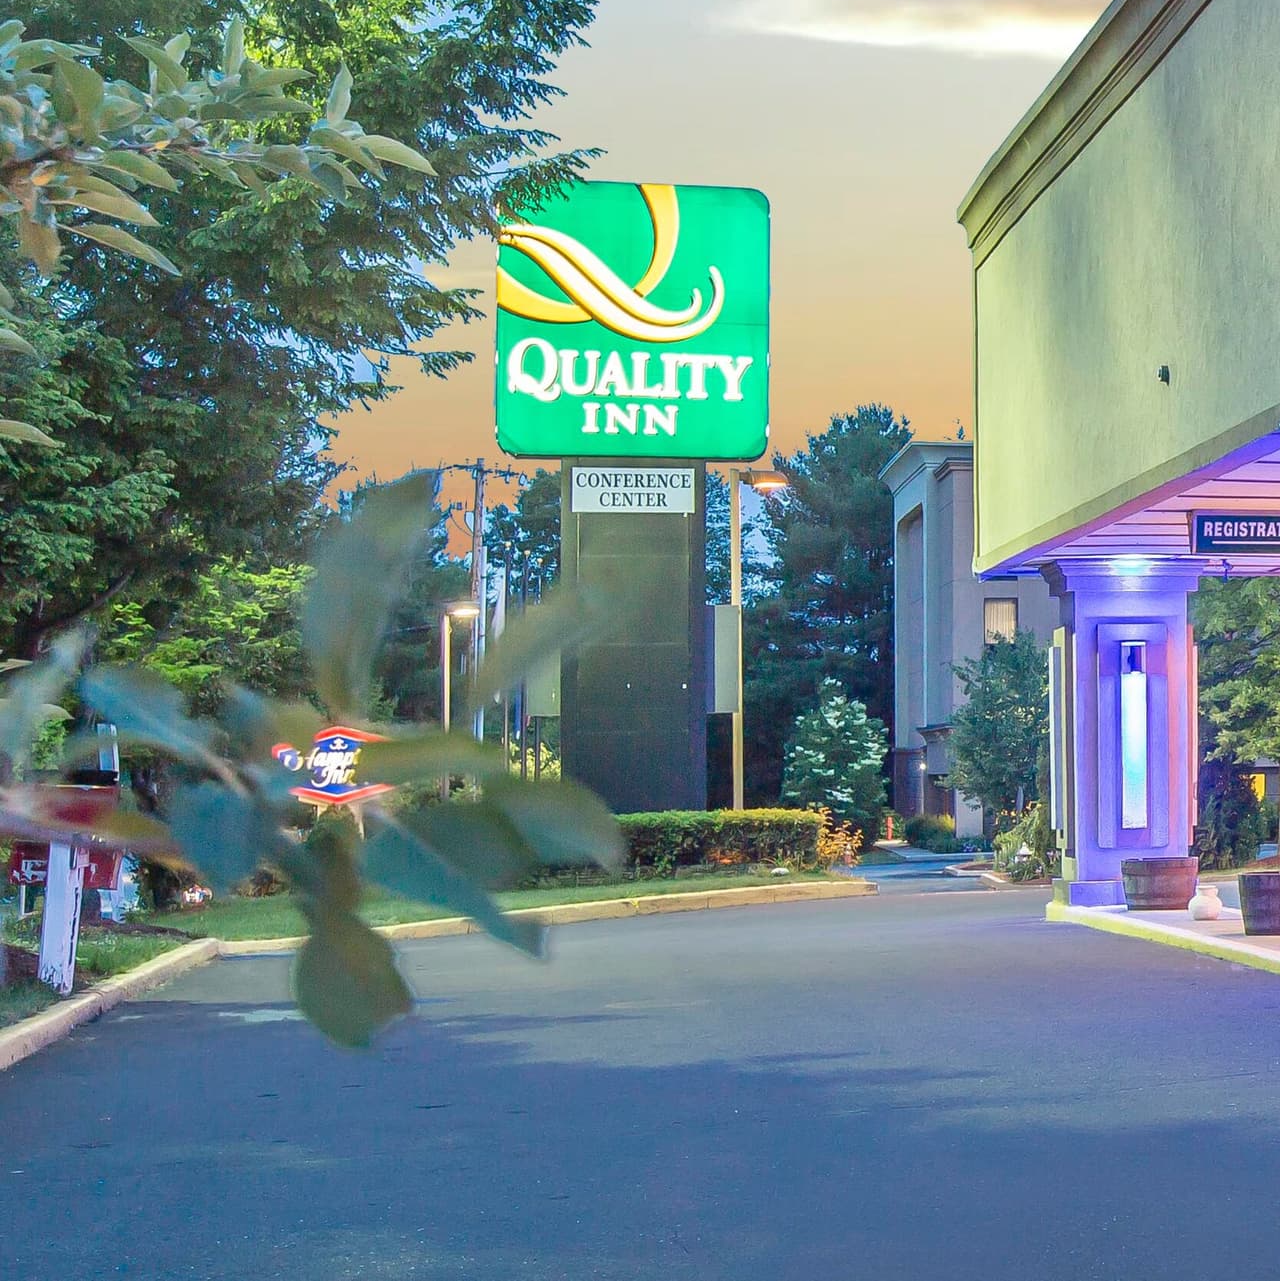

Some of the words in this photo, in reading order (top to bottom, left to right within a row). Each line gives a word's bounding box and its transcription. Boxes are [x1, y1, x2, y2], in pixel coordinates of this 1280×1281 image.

[508, 337, 753, 401] QUALITY
[582, 402, 679, 436] INN
[576, 473, 691, 489] CONFERENCE
[599, 492, 667, 508] CENTER
